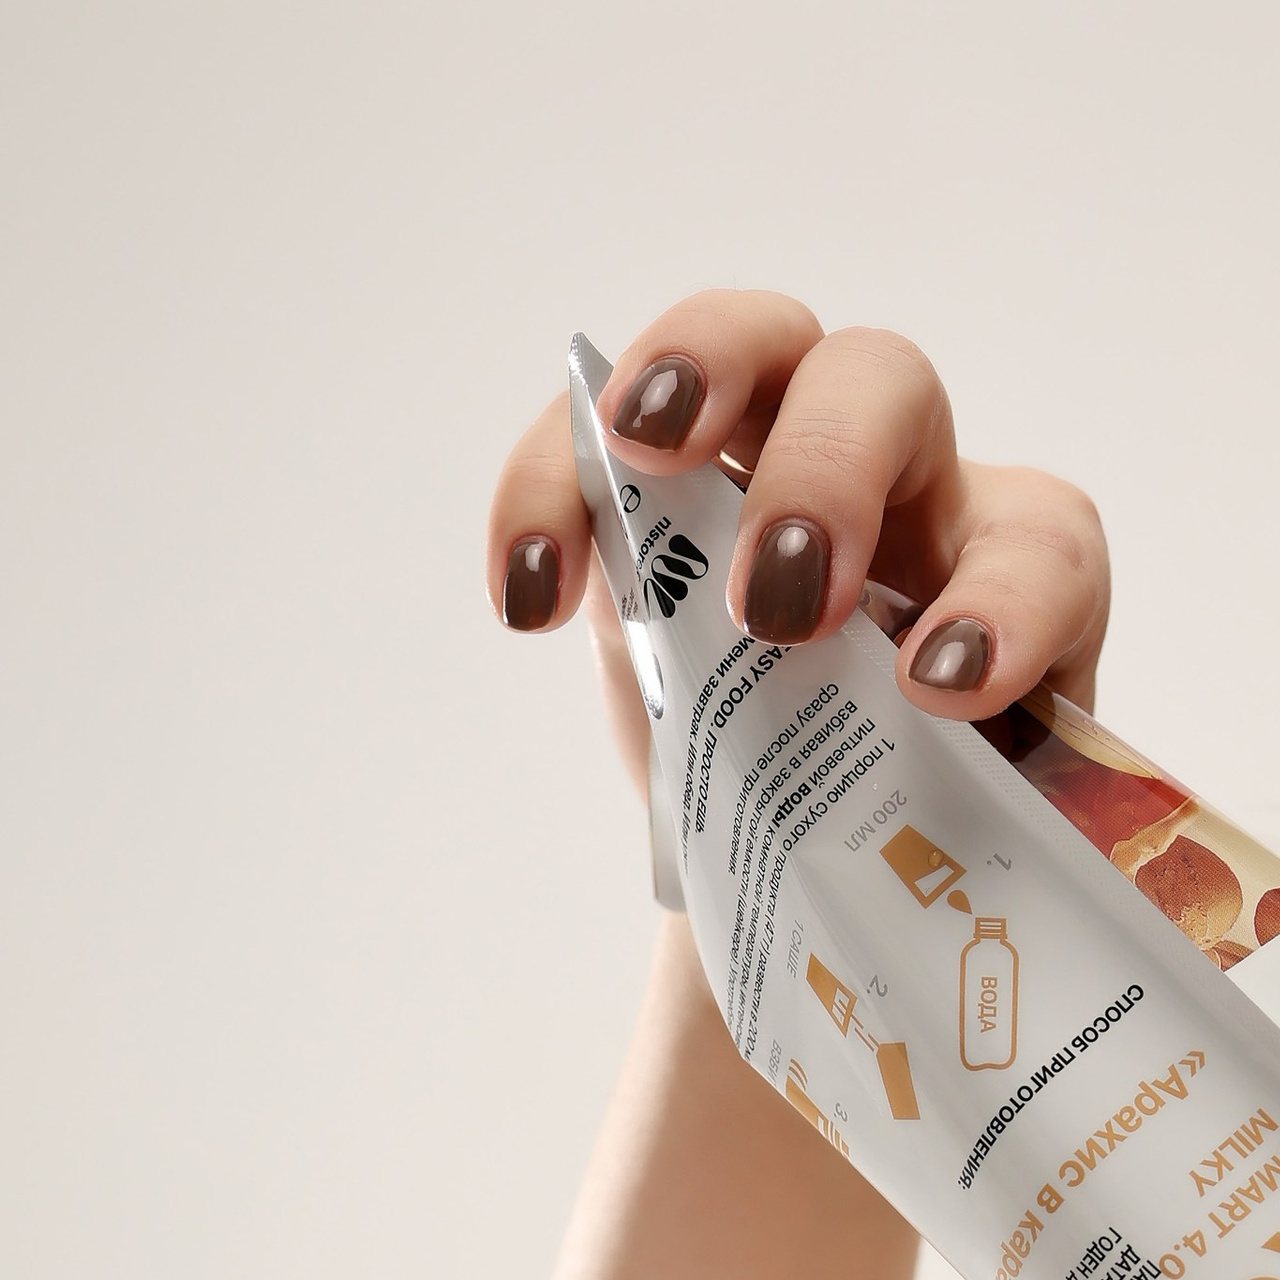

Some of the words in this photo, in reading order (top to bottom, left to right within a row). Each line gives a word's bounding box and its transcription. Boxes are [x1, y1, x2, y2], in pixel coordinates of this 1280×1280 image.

[750, 644, 792, 682] ASY
[690, 676, 719, 741] завтрак.
[711, 676, 753, 728] FOOD.
[797, 684, 839, 727] сразу
[757, 724, 799, 770] после
[799, 701, 858, 760] взбивая
[808, 718, 875, 788] питьевой
[881, 739, 894, 751] 1
[687, 742, 697, 773] Или
[699, 731, 717, 799] ПРОСТО
[789, 756, 802, 769] в
[827, 746, 883, 803] порцию
[683, 774, 693, 811] обед.
[695, 798, 706, 833] ЕШЬ.
[748, 768, 791, 842] закрытой
[772, 782, 812, 828] воды
[873, 790, 907, 824] 200
[728, 769, 760, 875] приготовления.
[783, 802, 828, 851] сухого
[844, 819, 876, 852] МЛ
[740, 838, 754, 897] емкости
[754, 826, 775, 902] комнатной
[767, 850, 786, 915] продукта
[987, 854, 1012, 871] 1.
[786, 930, 801, 978] САШЕ
[751, 951, 769, 1013] развести
[864, 975, 888, 997] 2.
[978, 977, 997, 1033] ВОДА
[745, 1020, 757, 1051] 200
[1072, 985, 1143, 1052] СПОСОБ
[958, 1047, 1076, 1189] ПРИГОТОВЛЕНИЯ:
[1059, 1051, 1205, 1187] «Арахис
[1189, 1109, 1279, 1197] MILKY
[1037, 1183, 1065, 1214] в
[1076, 1227, 1122, 1279] ГОДЕН
[1156, 1230, 1207, 1280] 4.0
